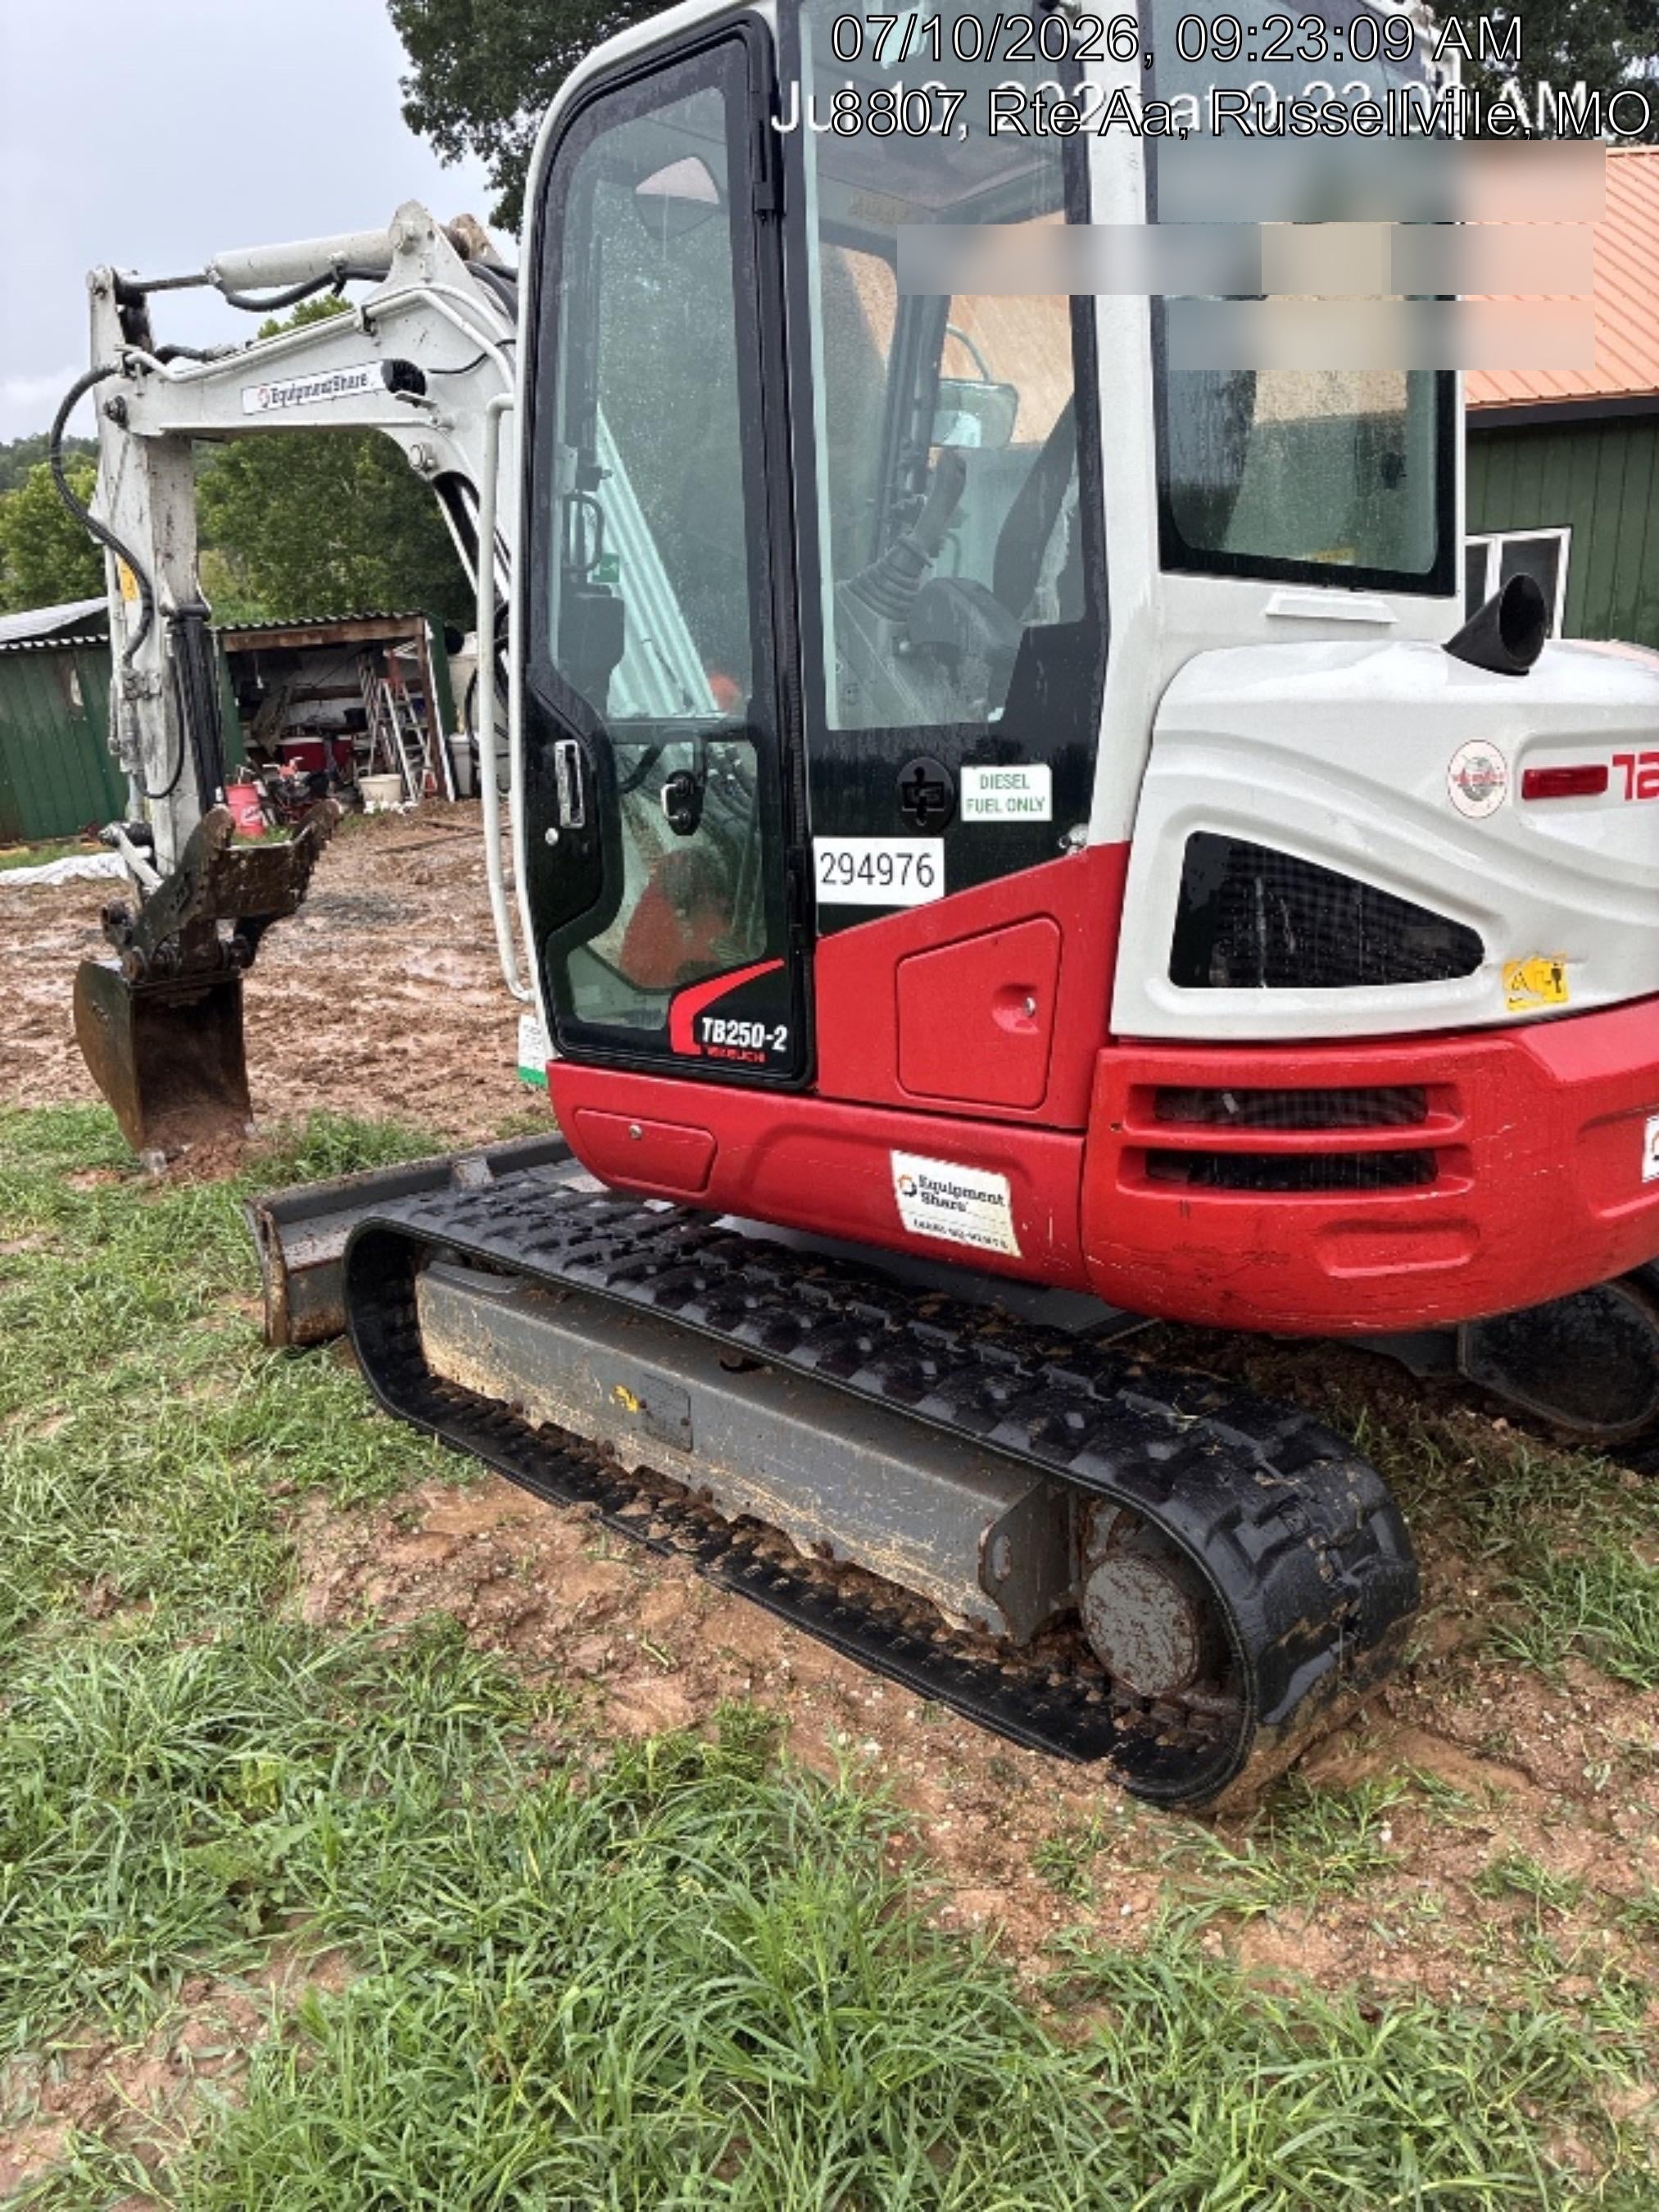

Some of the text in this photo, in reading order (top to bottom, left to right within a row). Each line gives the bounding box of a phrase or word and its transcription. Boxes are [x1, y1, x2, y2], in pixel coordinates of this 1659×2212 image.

[979, 773, 1031, 790] DIESEL
[966, 797, 1046, 814] FUEL ONLY
[820, 852, 935, 887] 294976
[702, 1016, 788, 1053] TB250-2
[918, 1174, 1006, 1207] Equipment
